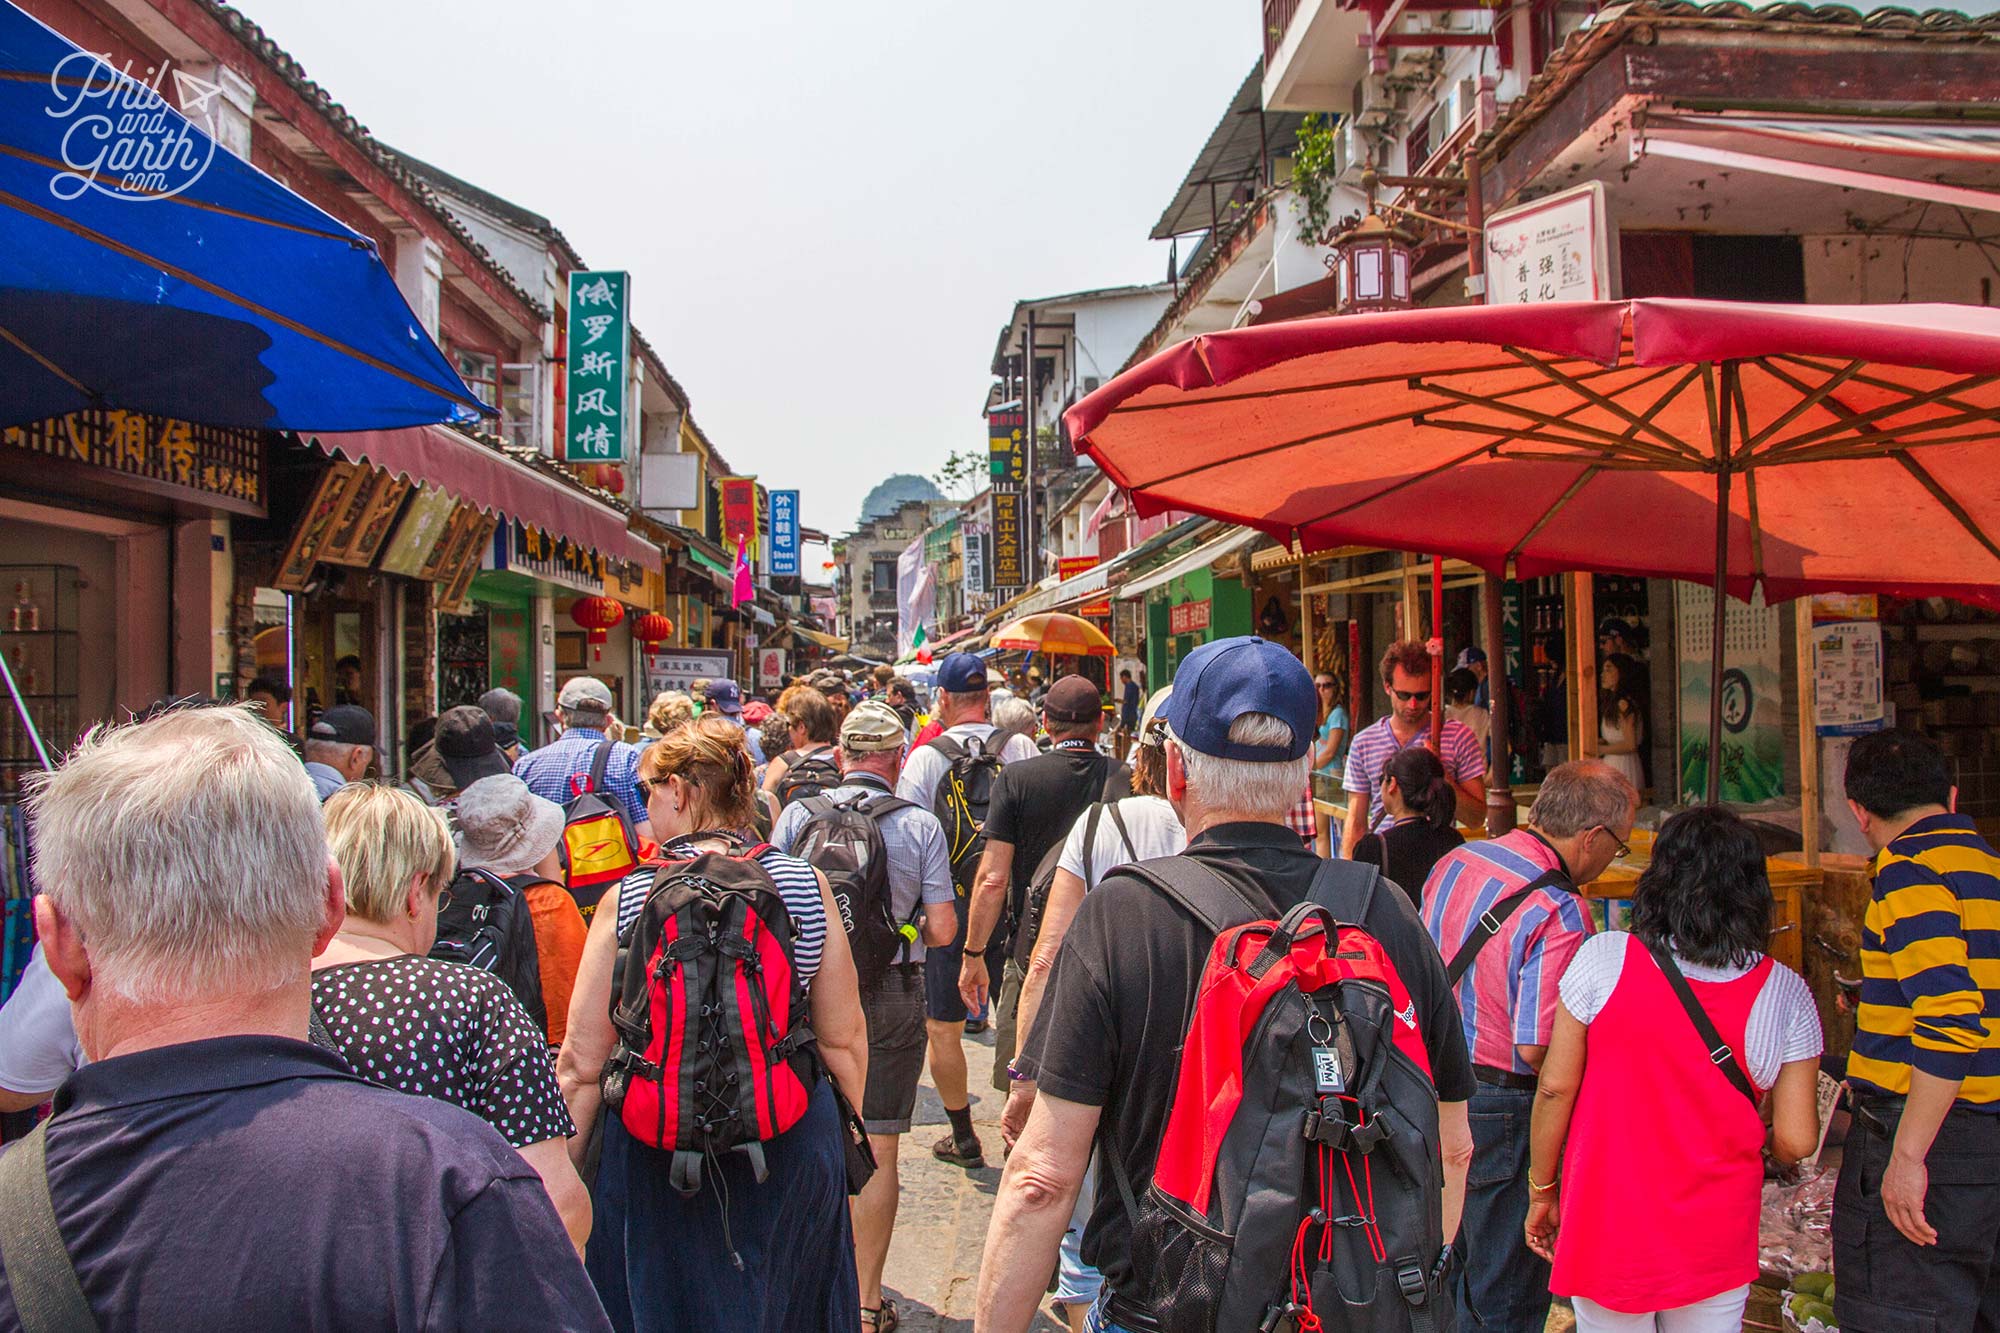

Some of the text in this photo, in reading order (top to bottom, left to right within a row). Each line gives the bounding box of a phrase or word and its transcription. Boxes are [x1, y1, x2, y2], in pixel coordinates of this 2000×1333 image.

[573, 276, 618, 456] 俄罗斯风情
[996, 495, 1017, 570] 阿里山大酒店
